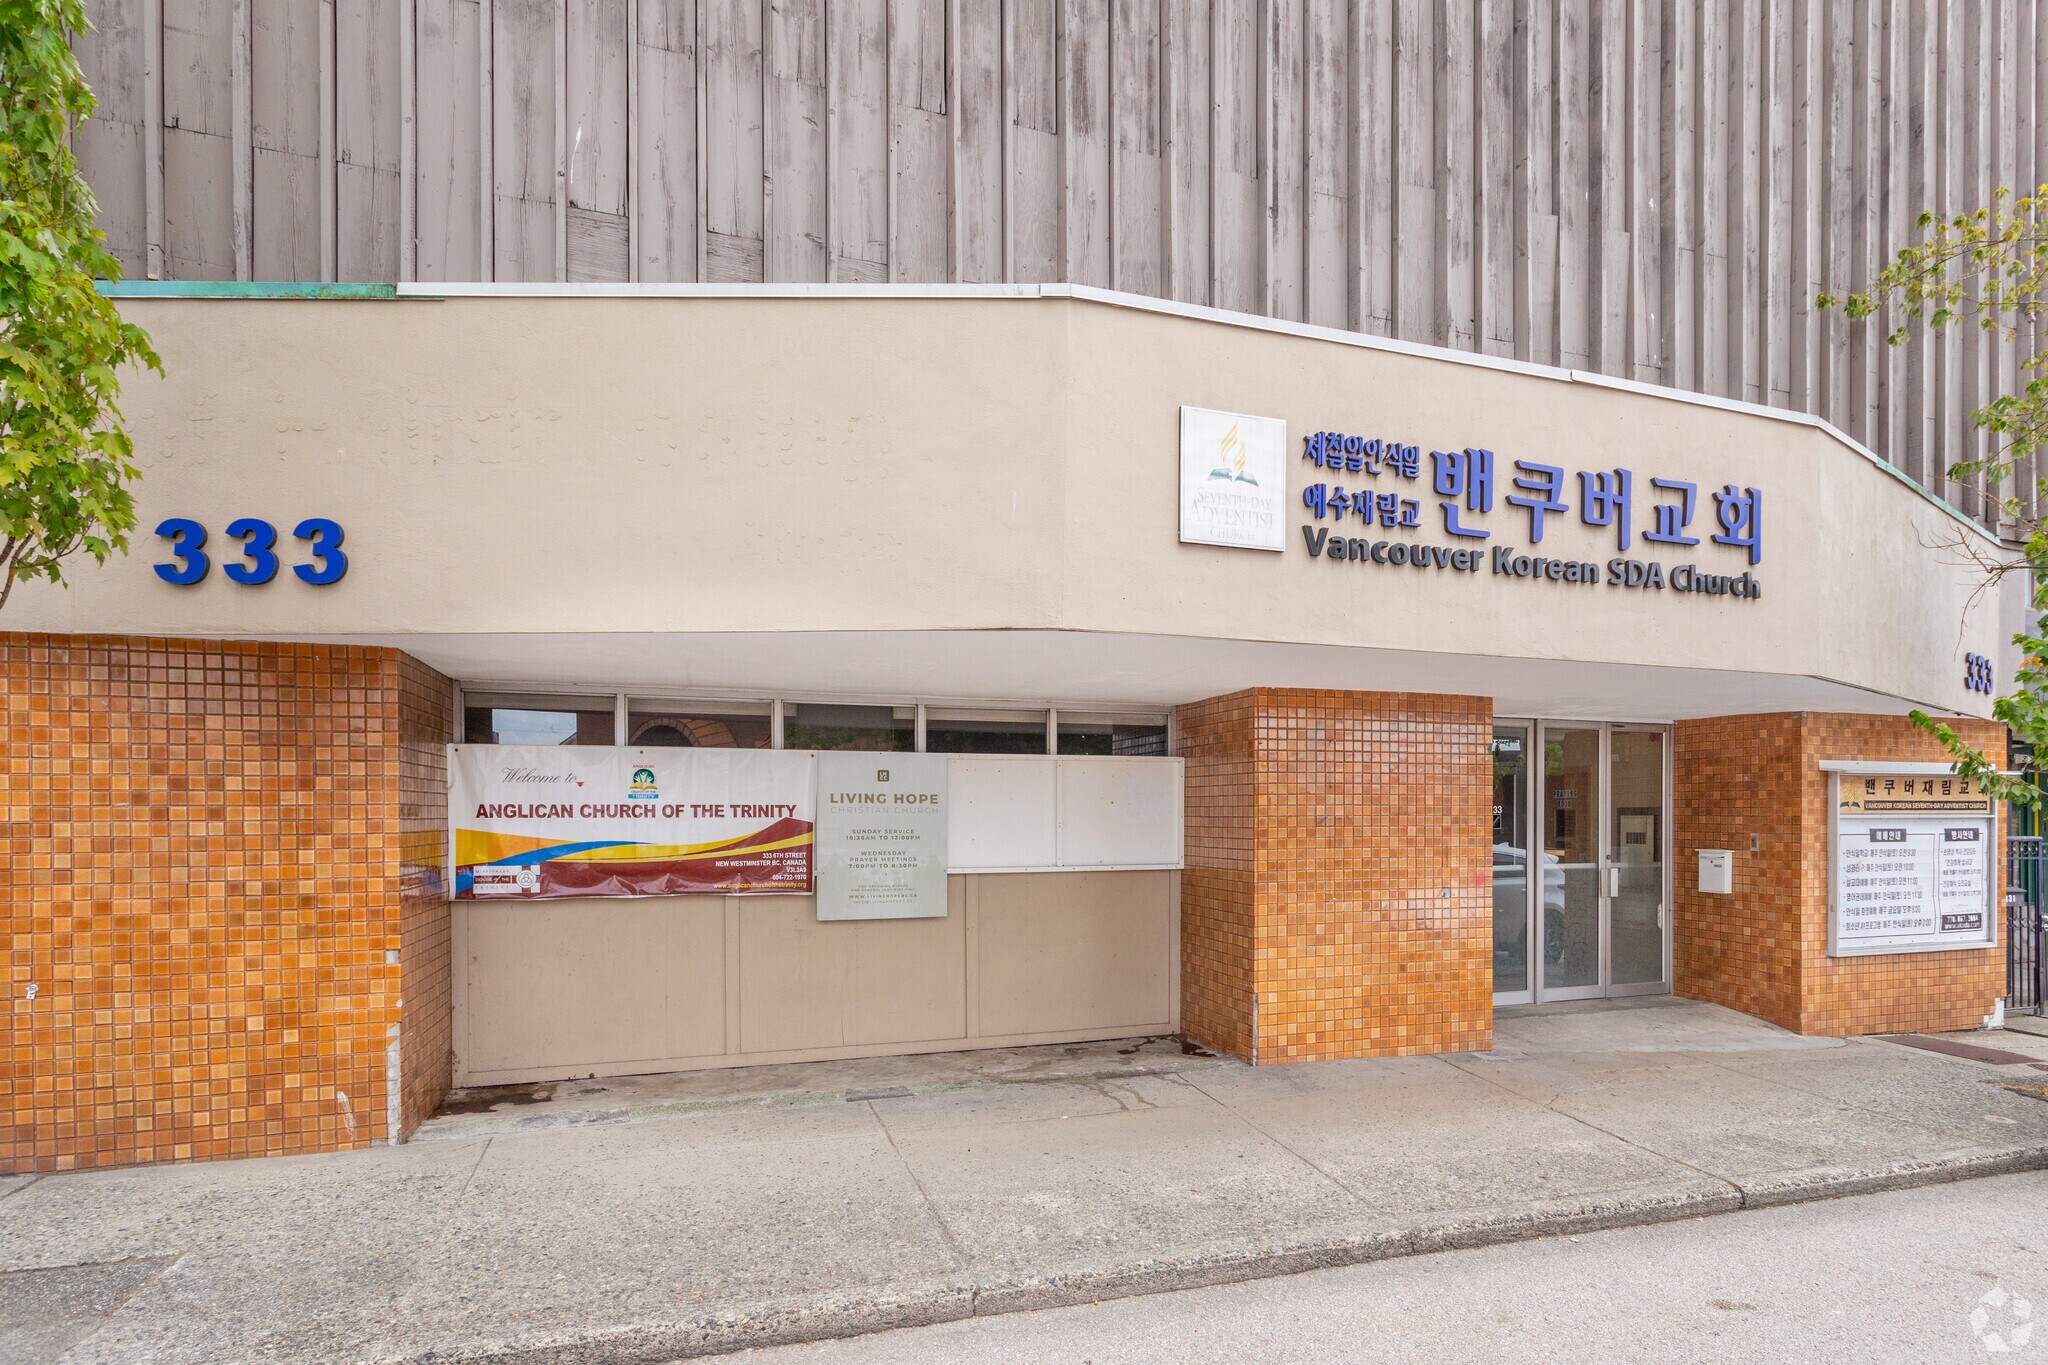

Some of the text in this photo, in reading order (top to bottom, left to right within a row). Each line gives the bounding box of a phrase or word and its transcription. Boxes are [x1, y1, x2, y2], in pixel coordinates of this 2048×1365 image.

[1303, 431, 1420, 478] 제칠일안식일
[1188, 499, 1275, 529] ADVENTIST
[1303, 482, 1421, 527] 예수재림교
[1430, 448, 1762, 566] 밴쿠버교회
[1210, 527, 1254, 541] CHURCH
[154, 518, 349, 585] 333
[1302, 525, 1761, 599] Vancouver Korean SDA Church
[1964, 652, 1994, 694] 333
[501, 767, 578, 784] Welcome to
[1864, 778, 1988, 796] 밴쿠버재림교
[476, 804, 797, 818] ANGLICAN CHURCH OF THE TRINITY
[830, 793, 939, 804] LIVING HOPE
[831, 806, 889, 814] CHRISTIAN
